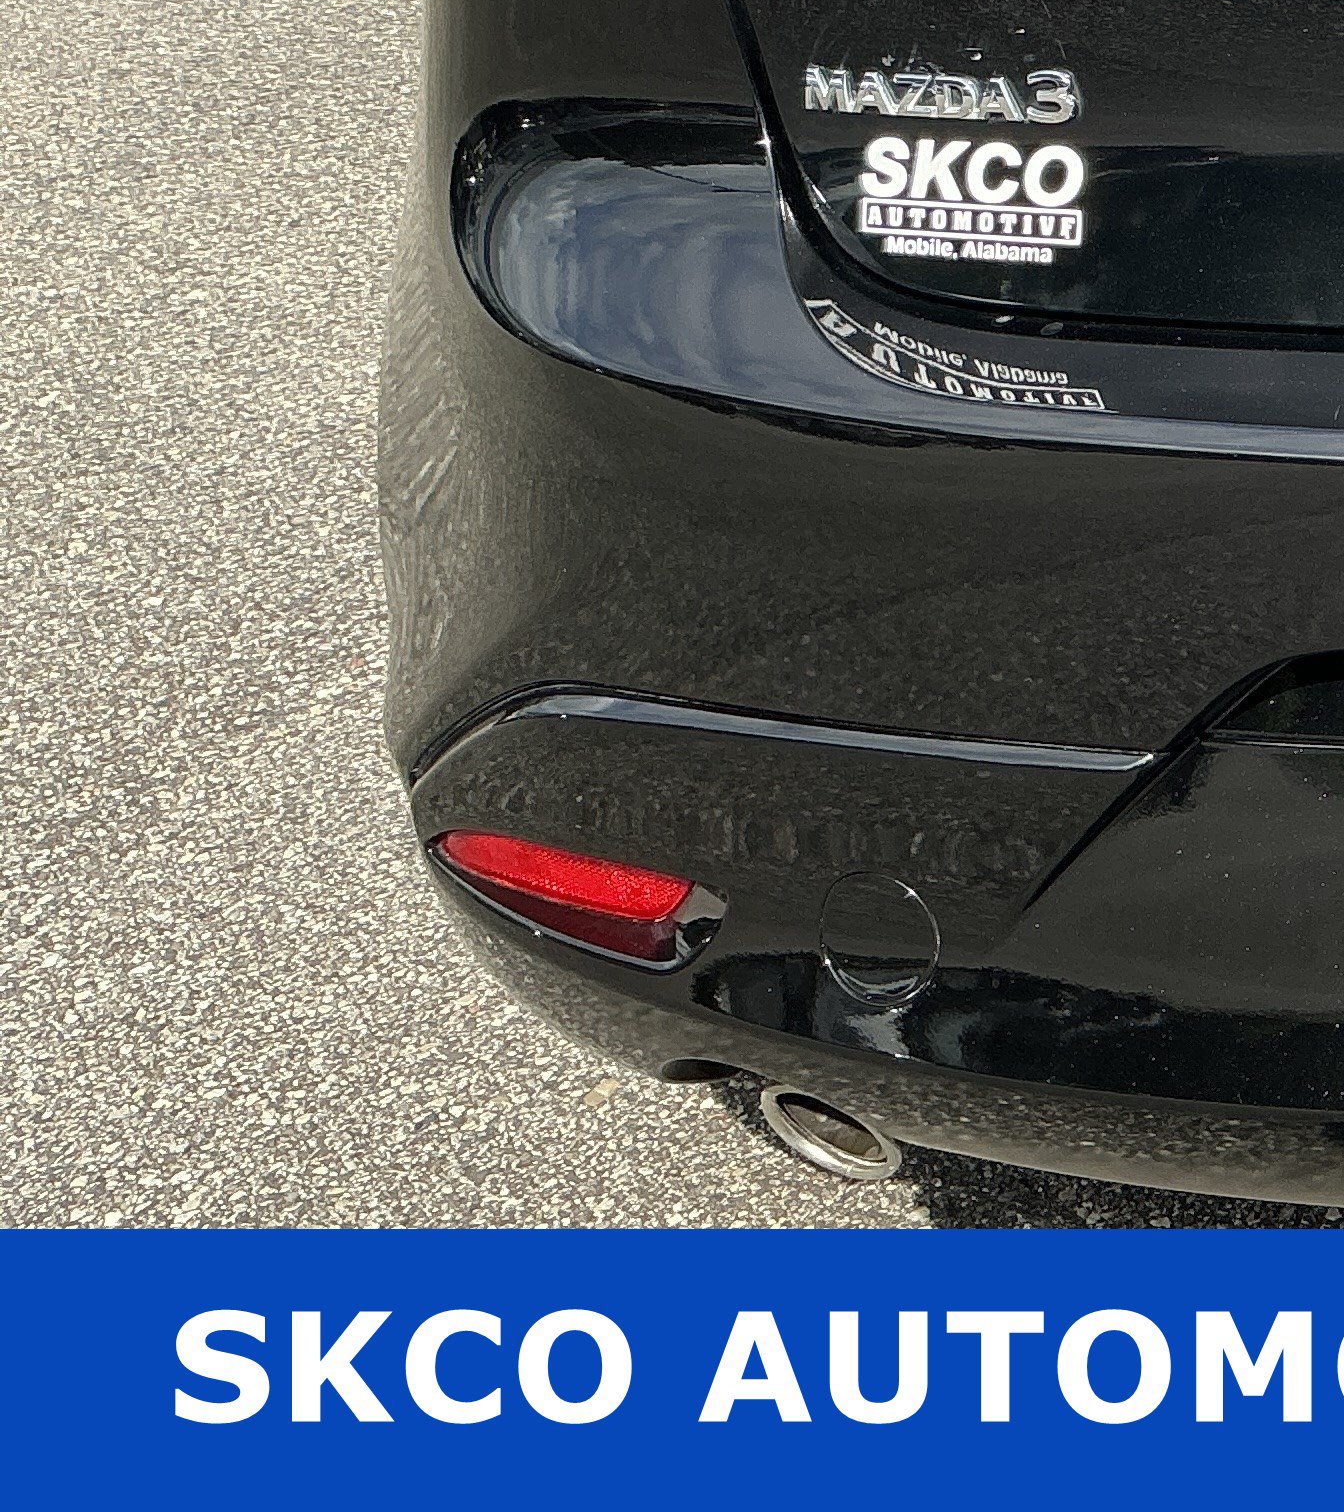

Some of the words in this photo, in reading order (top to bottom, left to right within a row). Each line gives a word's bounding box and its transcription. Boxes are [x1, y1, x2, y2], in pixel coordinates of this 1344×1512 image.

[804, 63, 1081, 124] MAZDA3
[861, 136, 1085, 208] SKCO
[867, 204, 1076, 240] AUTOMOTIVE
[886, 236, 959, 260] Mobile,
[962, 238, 1053, 264] Alabama
